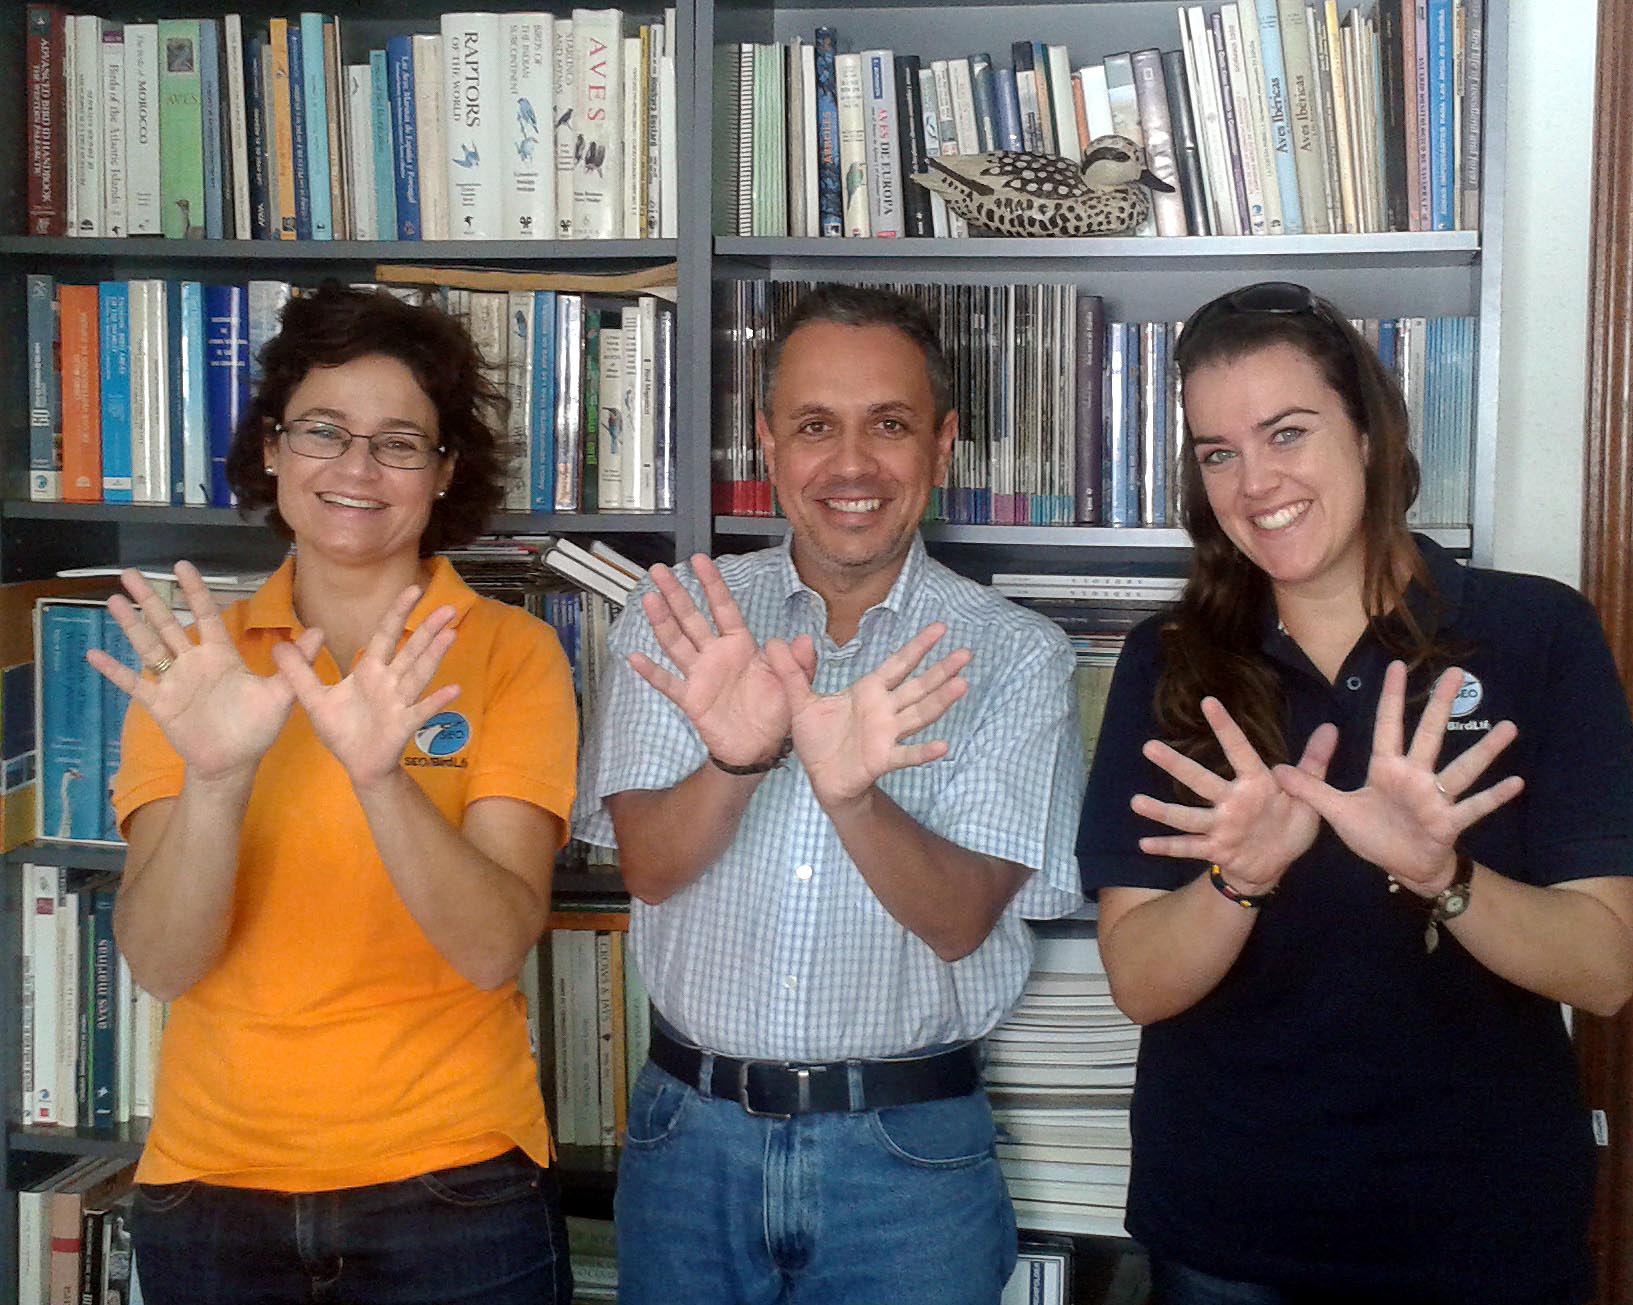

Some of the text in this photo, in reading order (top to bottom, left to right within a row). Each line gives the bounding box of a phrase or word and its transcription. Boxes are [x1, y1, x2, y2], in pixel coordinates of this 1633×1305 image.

[452, 81, 462, 122] WORLD
[465, 32, 481, 128] RAPTORS
[587, 37, 608, 121] AVES
[1271, 77, 1285, 123] Ibéricas
[110, 106, 121, 123] the
[138, 80, 149, 144] MOROCCO
[1294, 75, 1313, 152] Aves Ibéricas
[110, 128, 122, 165] Atlantic
[879, 108, 893, 216] AVES DE EUROPA
[1275, 125, 1288, 153] Aves
[110, 169, 122, 204] Islands
[1460, 689, 1478, 698] EO
[96, 939, 108, 1030] aves marinas
